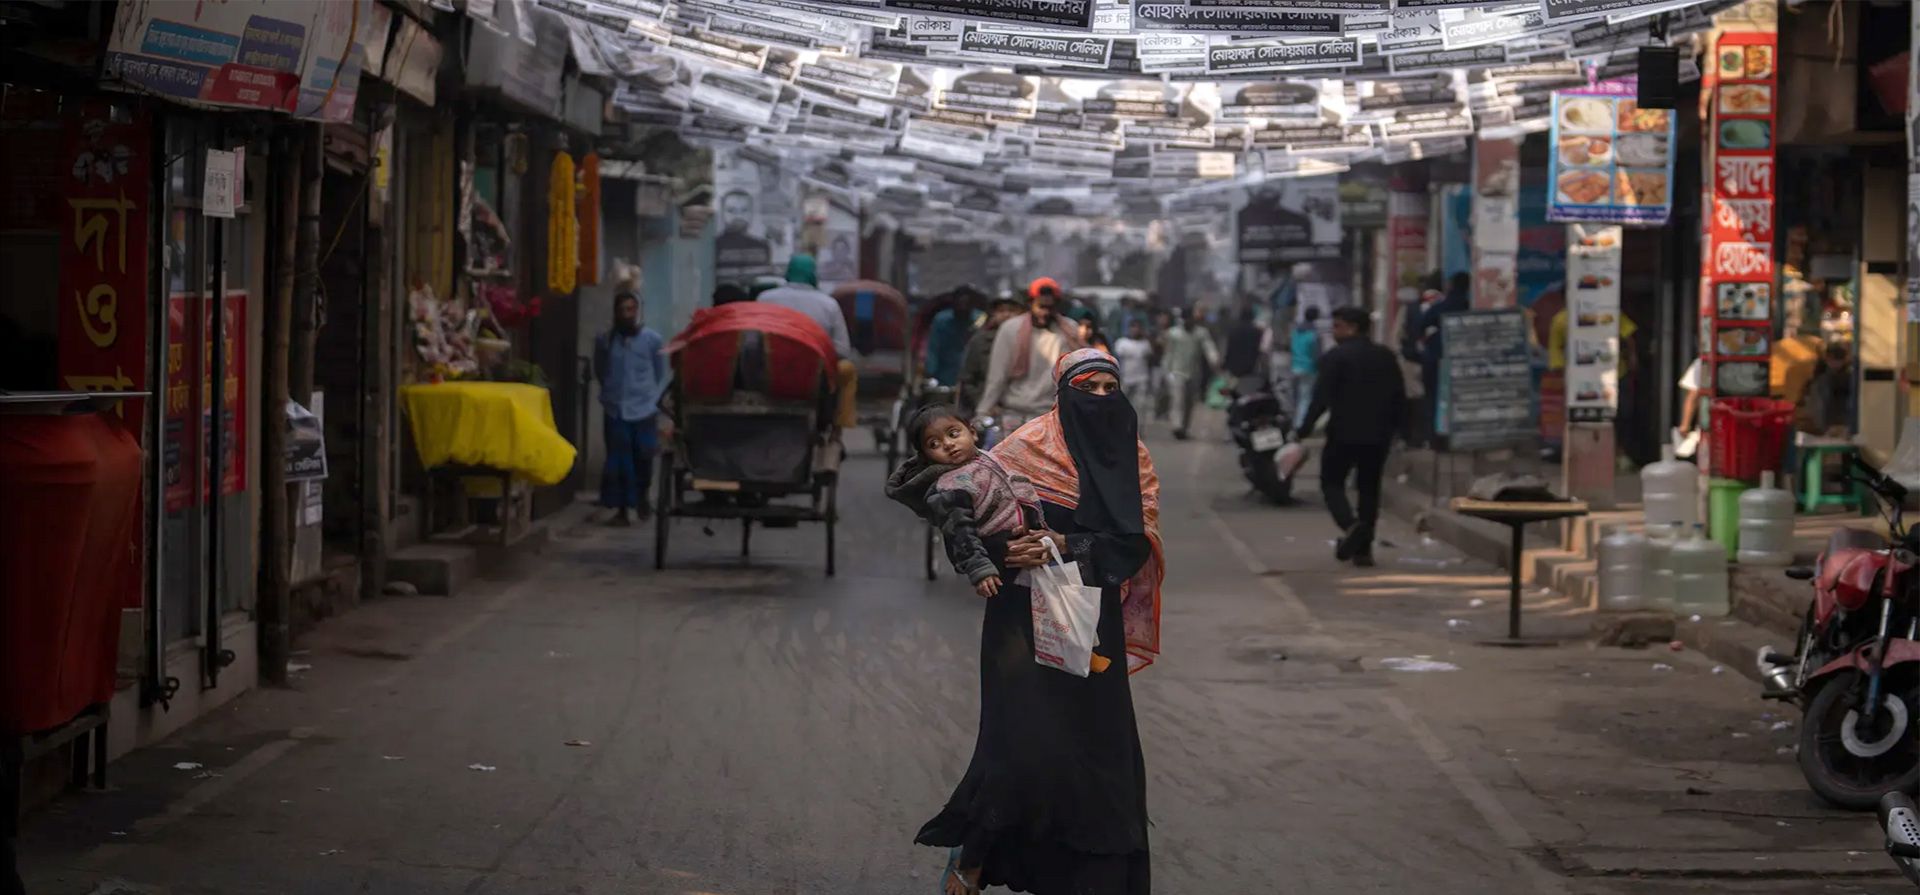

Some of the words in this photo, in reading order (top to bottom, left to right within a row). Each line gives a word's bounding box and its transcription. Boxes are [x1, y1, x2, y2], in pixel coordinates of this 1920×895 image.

[914, 16, 951, 31] নৌকায়
[1383, 26, 1421, 40] নৌকায়
[965, 31, 1009, 46] মোহাম্মদ
[1010, 35, 1068, 53] সোলায়মান
[1070, 38, 1105, 56] সেলিম
[1144, 33, 1182, 46] নৌকায়
[1211, 47, 1255, 62] মোহাম্মদ
[1258, 42, 1317, 59] সোলায়মান
[1320, 38, 1354, 54] সেলিম
[1717, 155, 1773, 196] স্বাদে
[1715, 232, 1772, 276] হোটেল
